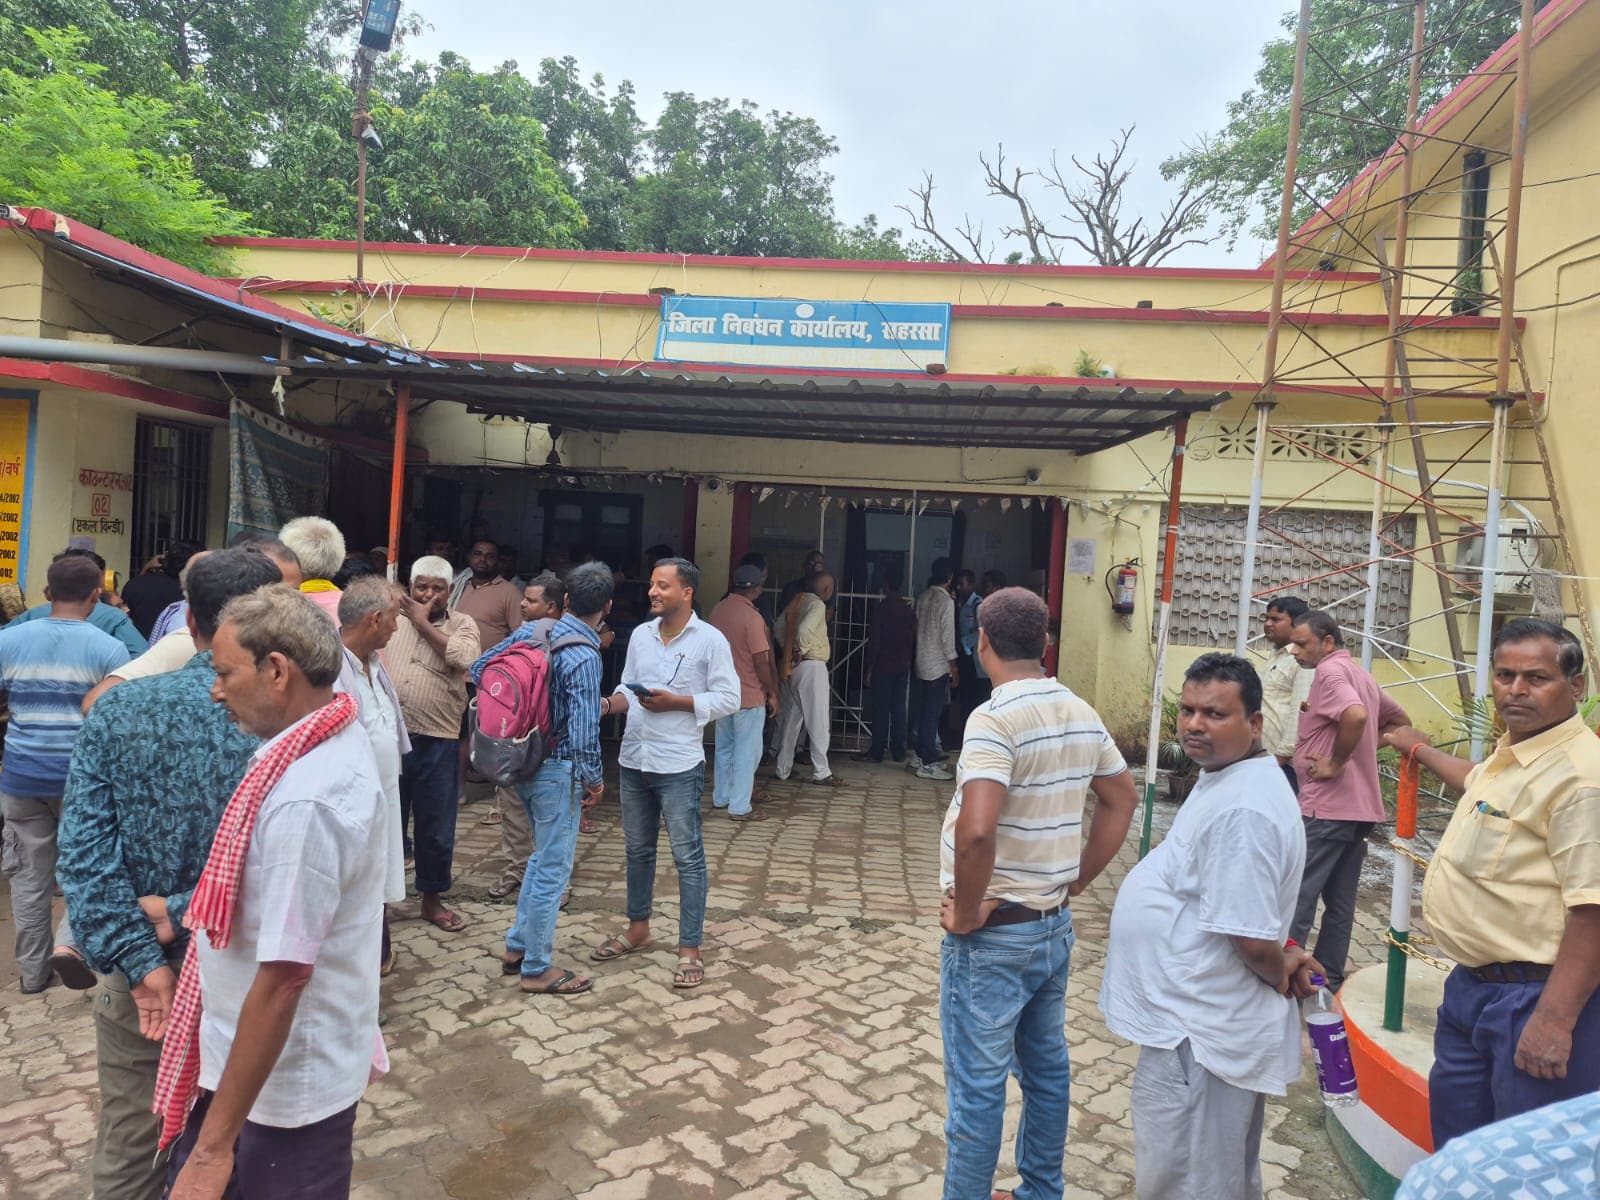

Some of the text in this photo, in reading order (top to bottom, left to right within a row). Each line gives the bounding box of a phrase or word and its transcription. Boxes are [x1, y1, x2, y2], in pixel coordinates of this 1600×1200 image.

[668, 311, 943, 343] जिला निबंधन कार्यालय, सहरसा
